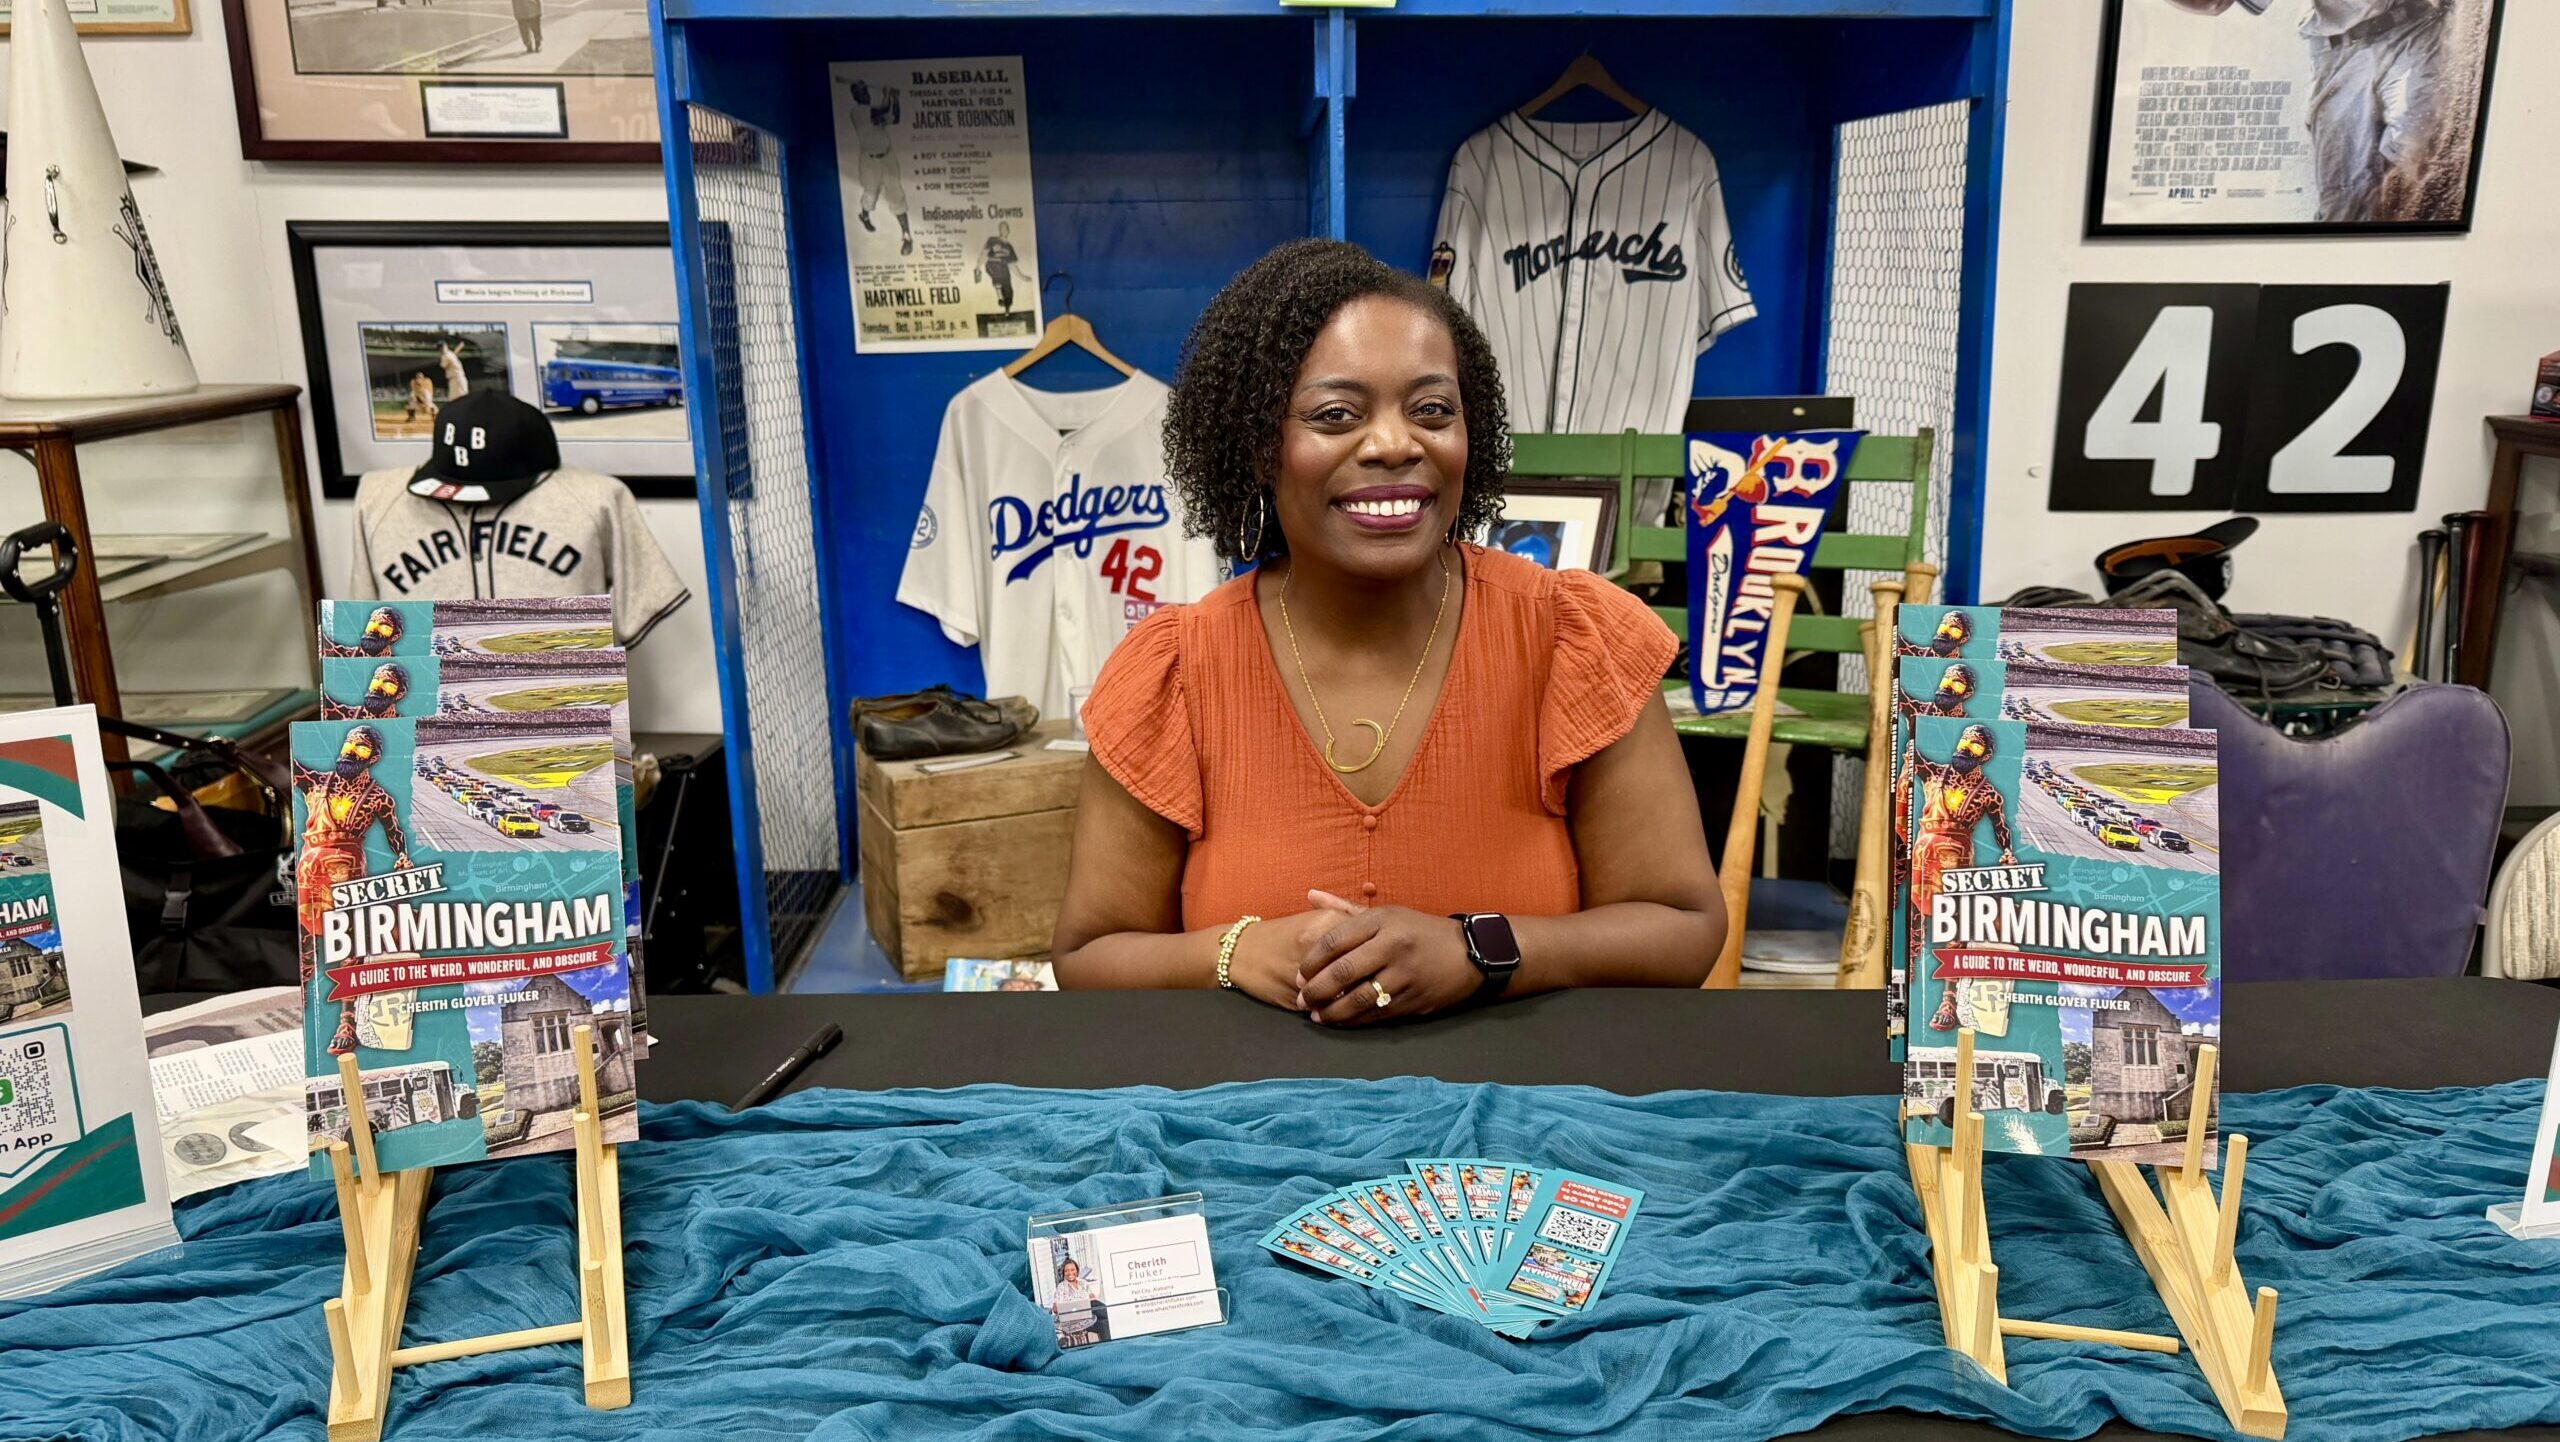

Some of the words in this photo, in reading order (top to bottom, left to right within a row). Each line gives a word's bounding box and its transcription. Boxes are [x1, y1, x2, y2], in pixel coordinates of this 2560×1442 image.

[912, 70, 1008, 84] BASEBALL
[922, 99, 974, 108] HARTWELL
[979, 97, 1005, 106] FIELD
[913, 110, 953, 129] JACKIE
[958, 109, 1015, 128] ROBINSON
[2168, 188, 2194, 198] APRIL
[922, 205, 983, 223] Indianapolis
[988, 204, 1023, 219] Clowns
[1504, 222, 1686, 293] Monarchs
[864, 288, 925, 308] HARTWELL
[930, 286, 960, 305] FIELD
[2084, 303, 2407, 496] 42
[444, 423, 456, 446] B
[471, 427, 486, 449] B
[454, 446, 469, 467] B
[989, 473, 1170, 587] Dodgers
[383, 519, 582, 595] FAIRFIELD
[1101, 539, 1162, 602] 42
[332, 865, 442, 908] SECRET
[496, 880, 548, 894] Birmingham
[1942, 867, 2044, 893] SECRET
[2094, 892, 2144, 902] Birmingham
[322, 894, 611, 964] BIRMINGHAM
[1932, 894, 2206, 956] BIRMINGHAM
[350, 972, 357, 988] A
[358, 968, 390, 986] GUIDE
[392, 967, 406, 982] TO
[408, 964, 427, 980] THE
[430, 963, 466, 979] WEIRD,
[468, 958, 531, 976] WONDERFUL,
[533, 954, 552, 969] AND
[555, 950, 598, 967] OBSCURE
[1954, 954, 1960, 970] A
[1962, 954, 1990, 970] GUIDE
[1993, 955, 2005, 971] TO
[2007, 957, 2026, 972] THE
[2028, 958, 2062, 976] WEIRD,
[2064, 962, 2124, 982] WONDERFUL,
[2126, 967, 2146, 982] AND
[2148, 968, 2191, 982] OBSCURE
[399, 998, 448, 1014] CHERITH
[450, 996, 495, 1009] GLOVER
[498, 990, 540, 1005] FLUKER
[1997, 992, 2044, 1007] CHERITH
[2046, 994, 2088, 1008] GLOVER
[2090, 997, 2131, 1012] FLUKER
[14, 1133, 53, 1151] App
[1127, 1256, 1167, 1270] Cherith
[1128, 1268, 1163, 1280] Fluker
[1520, 1265, 1591, 1291] BIRMINGHAM
